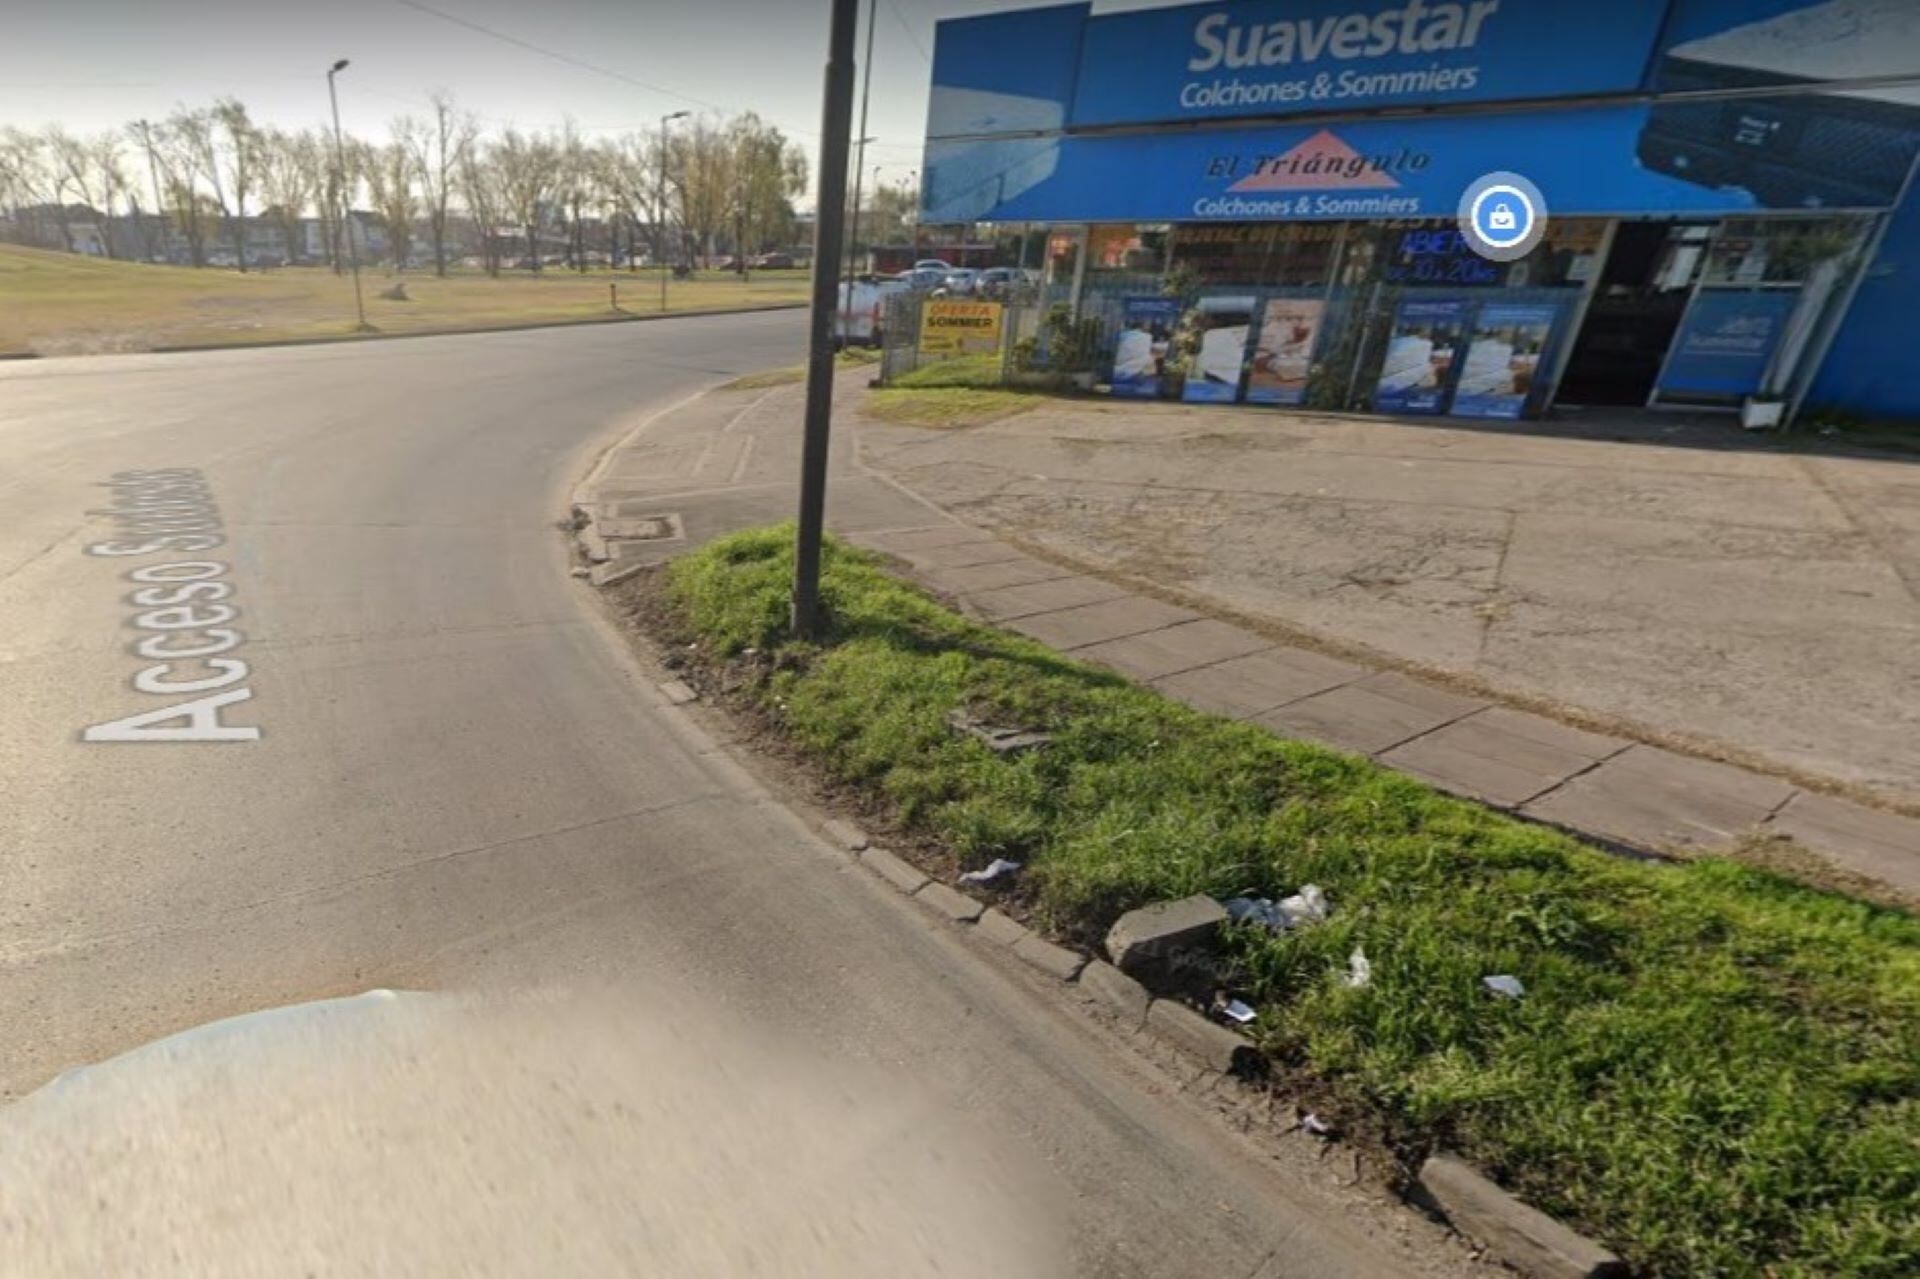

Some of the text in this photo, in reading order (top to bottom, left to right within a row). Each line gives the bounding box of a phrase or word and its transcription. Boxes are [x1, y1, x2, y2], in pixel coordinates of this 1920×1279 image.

[1187, 0, 1497, 71] Suavestar
[1179, 63, 1480, 108] Colchones & Sommiers
[1207, 149, 1432, 179] El Triángulo
[1193, 194, 1420, 217] Colchones & Sommiers
